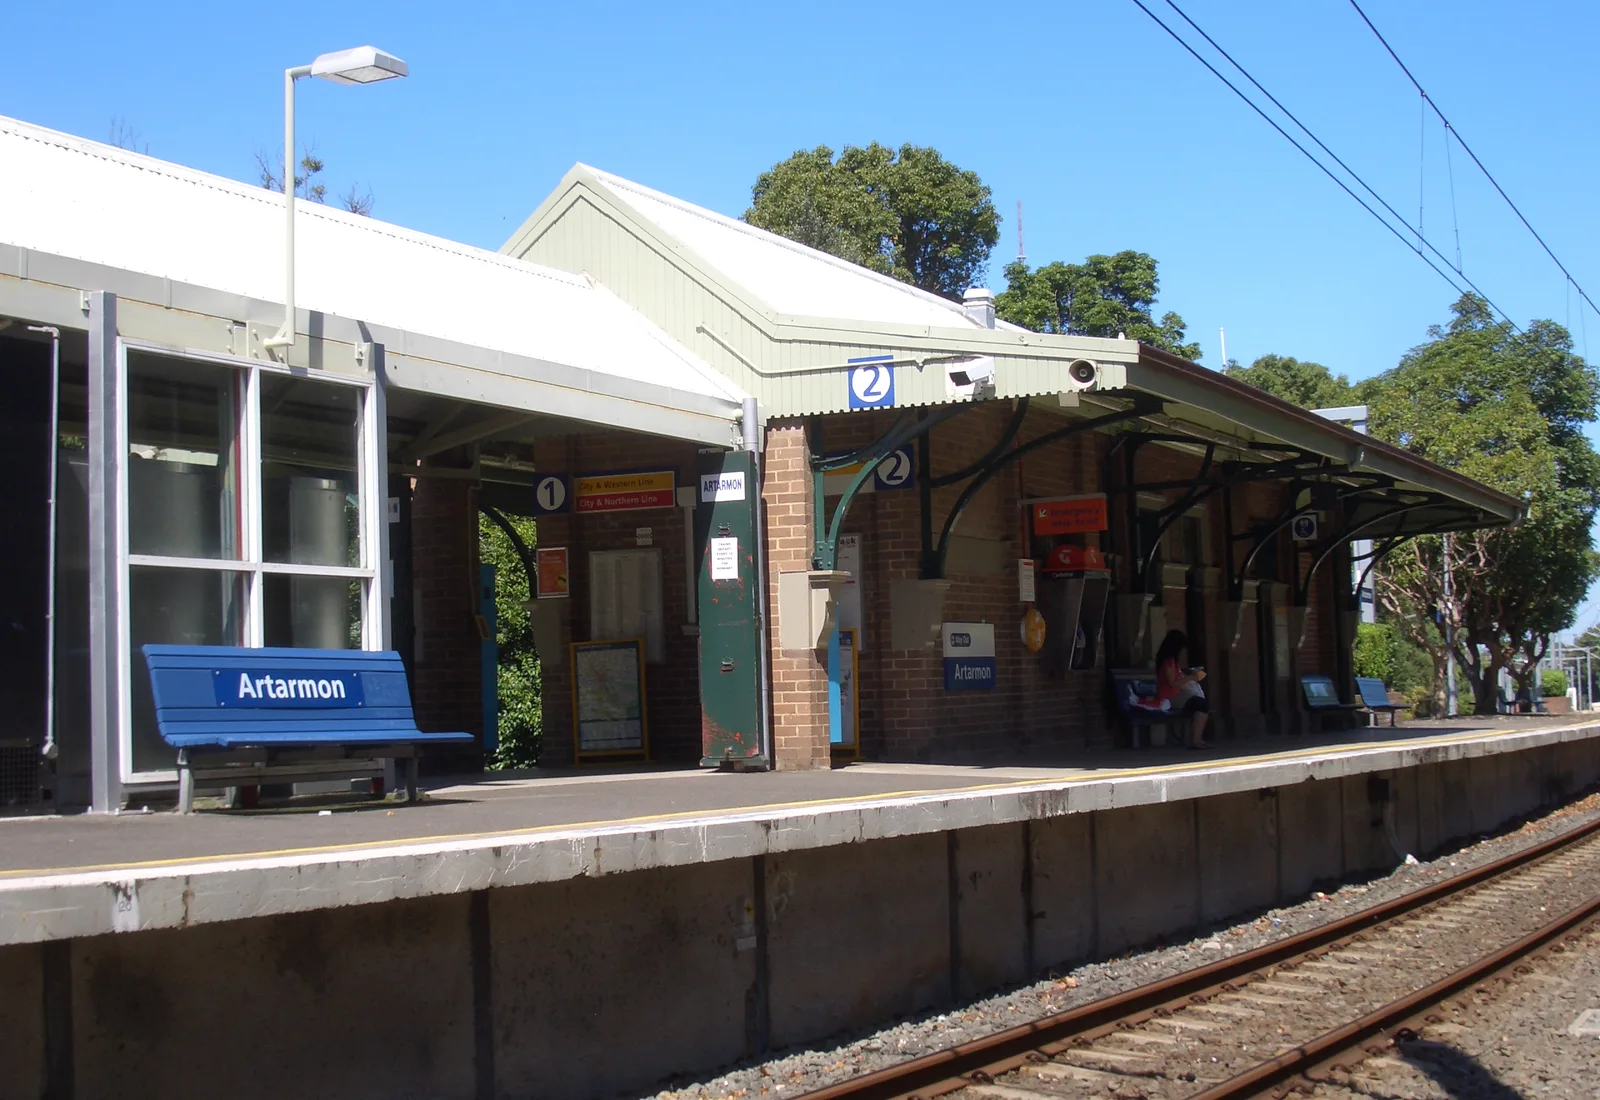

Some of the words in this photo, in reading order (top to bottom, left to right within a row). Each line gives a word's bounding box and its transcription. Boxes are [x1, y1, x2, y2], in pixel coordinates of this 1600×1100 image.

[862, 365, 882, 397] 2
[886, 452, 904, 481] 2
[579, 482, 593, 491] City
[603, 480, 636, 489] Western
[638, 478, 654, 486] Line
[703, 478, 742, 493] ARTARMON
[544, 481, 555, 506] 1
[579, 499, 595, 509] City
[596, 498, 603, 506] &
[604, 496, 639, 506] Northern
[641, 495, 658, 503] Line
[839, 536, 856, 550] ack
[954, 663, 992, 680] Artarmon
[239, 672, 346, 699] Artarmon
